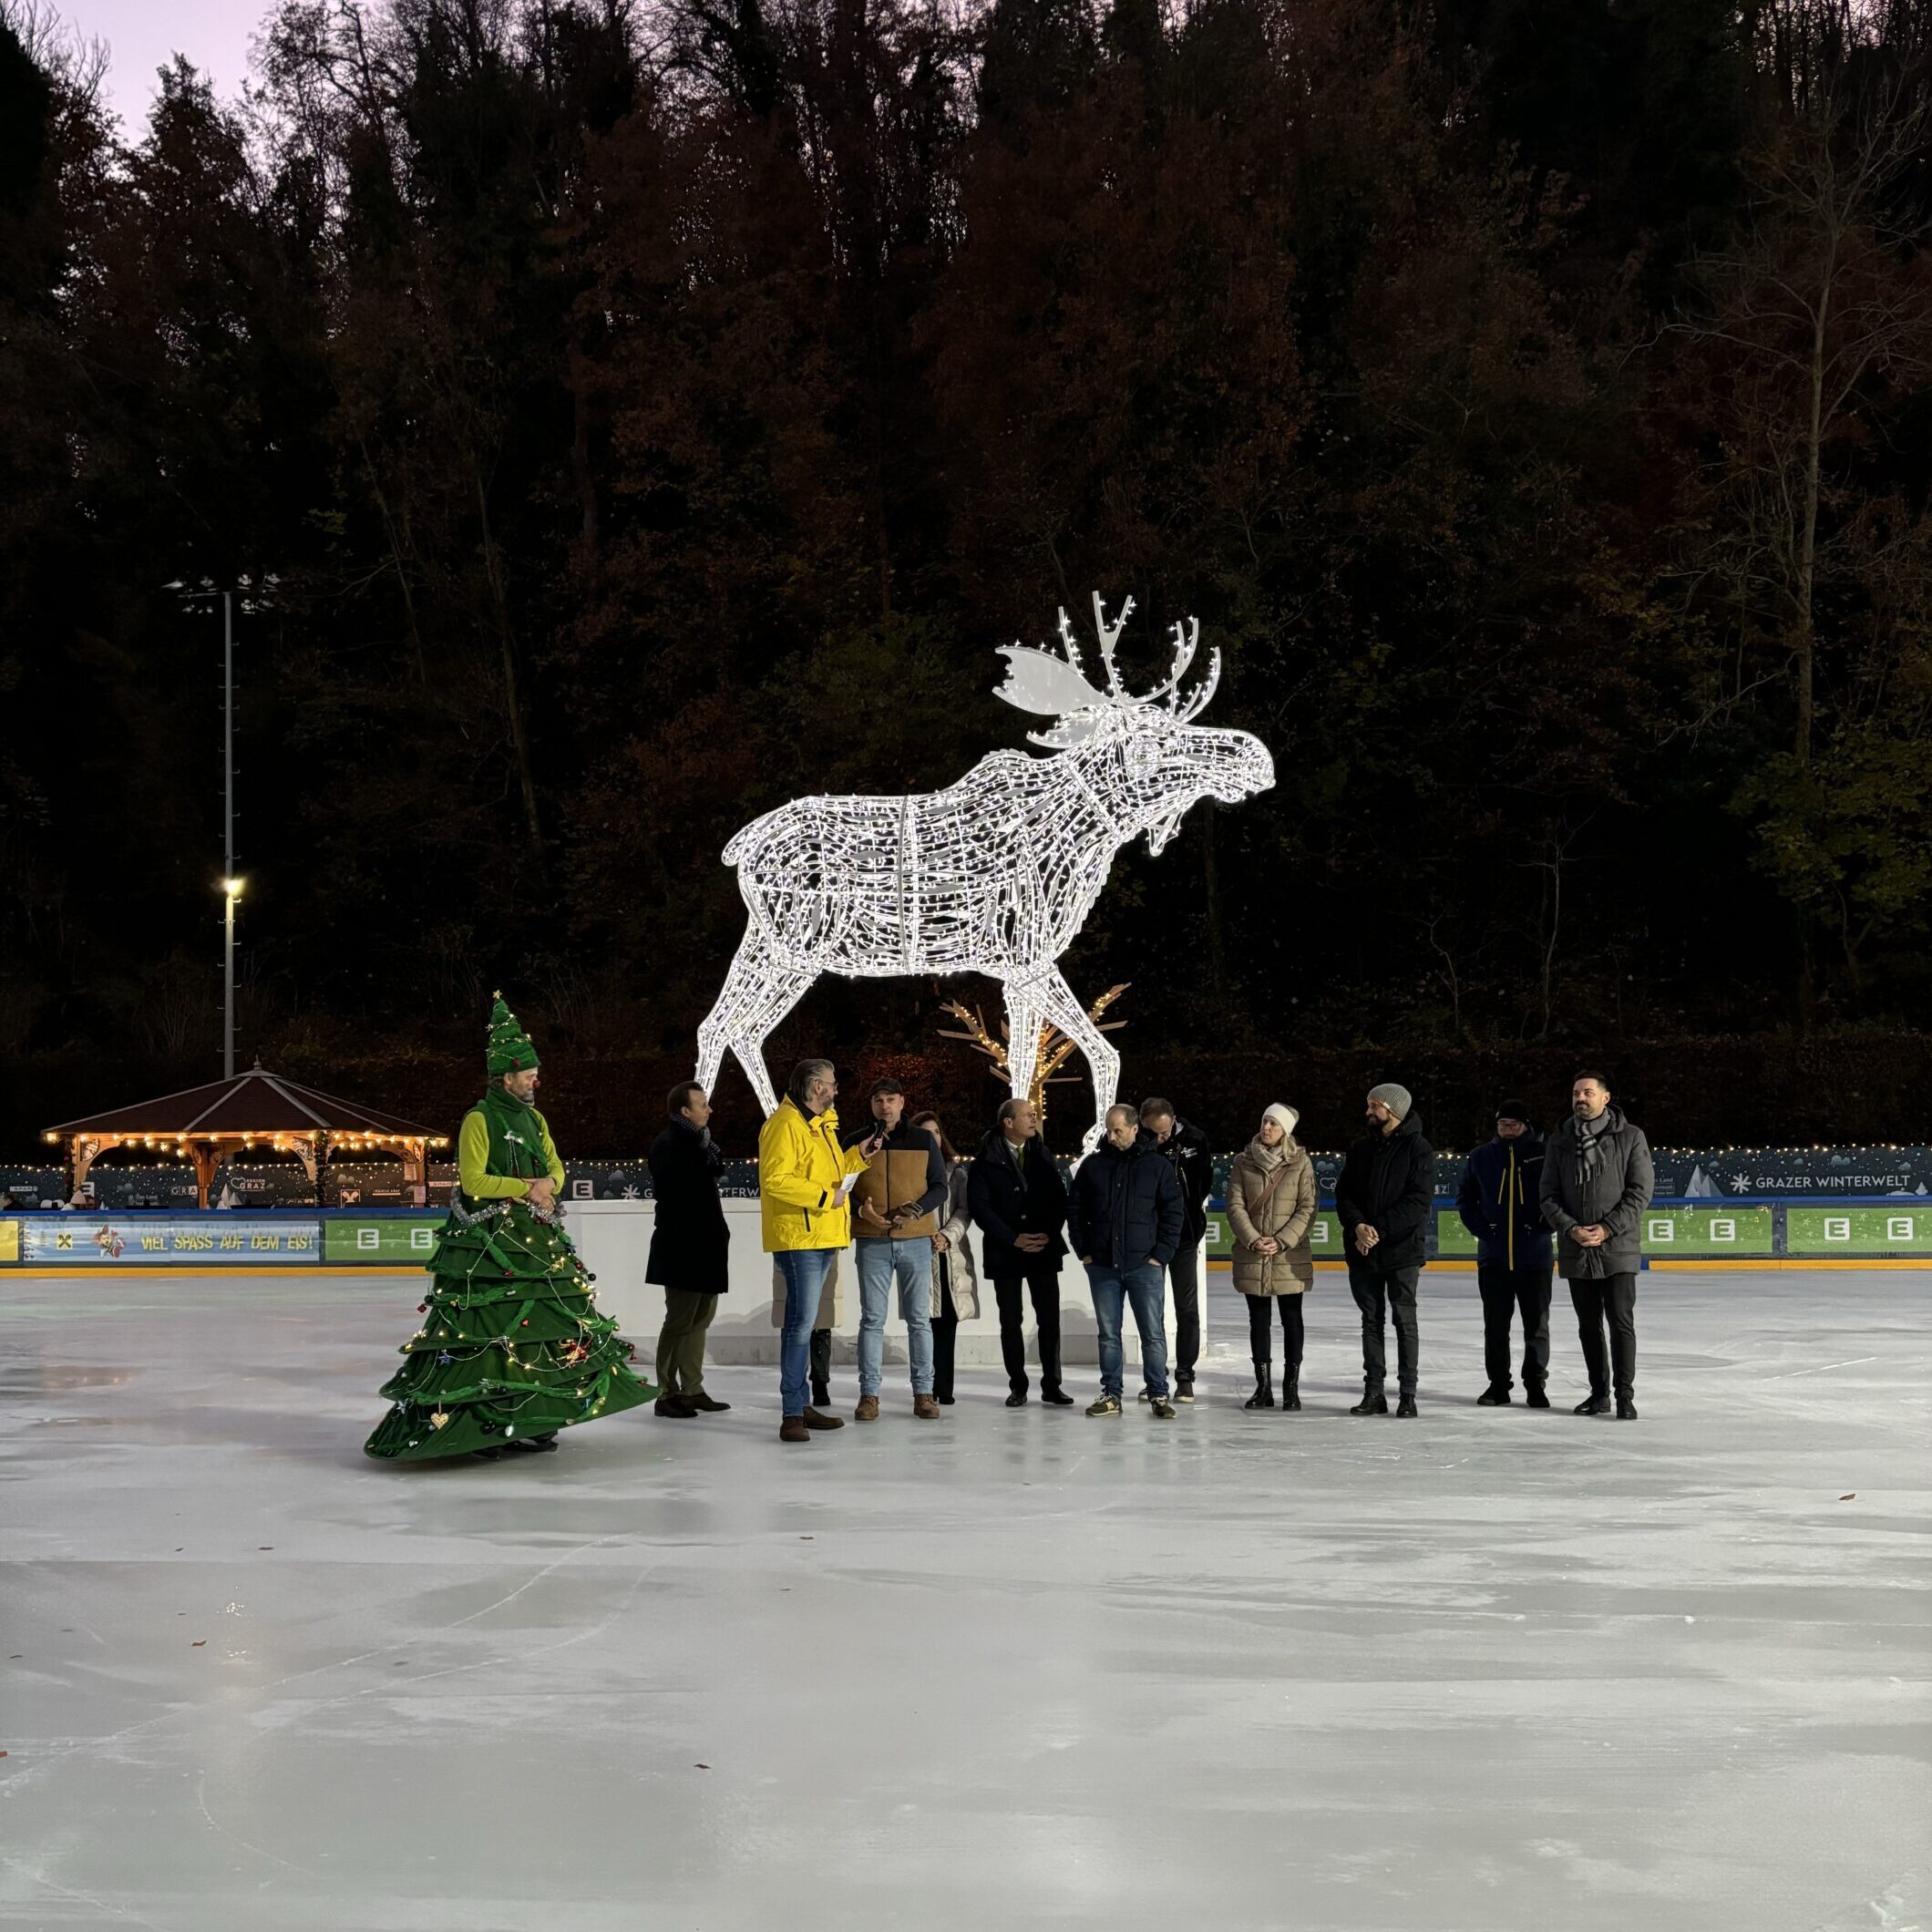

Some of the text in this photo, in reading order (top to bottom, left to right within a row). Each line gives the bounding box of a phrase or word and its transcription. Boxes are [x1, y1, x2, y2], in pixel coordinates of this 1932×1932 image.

[1755, 1175, 1910, 1188] GRAZER WINTERWELT
[170, 1185, 199, 1196] GRA
[140, 1235, 313, 1250] VIEL SPASS AUF DEM EIS!
